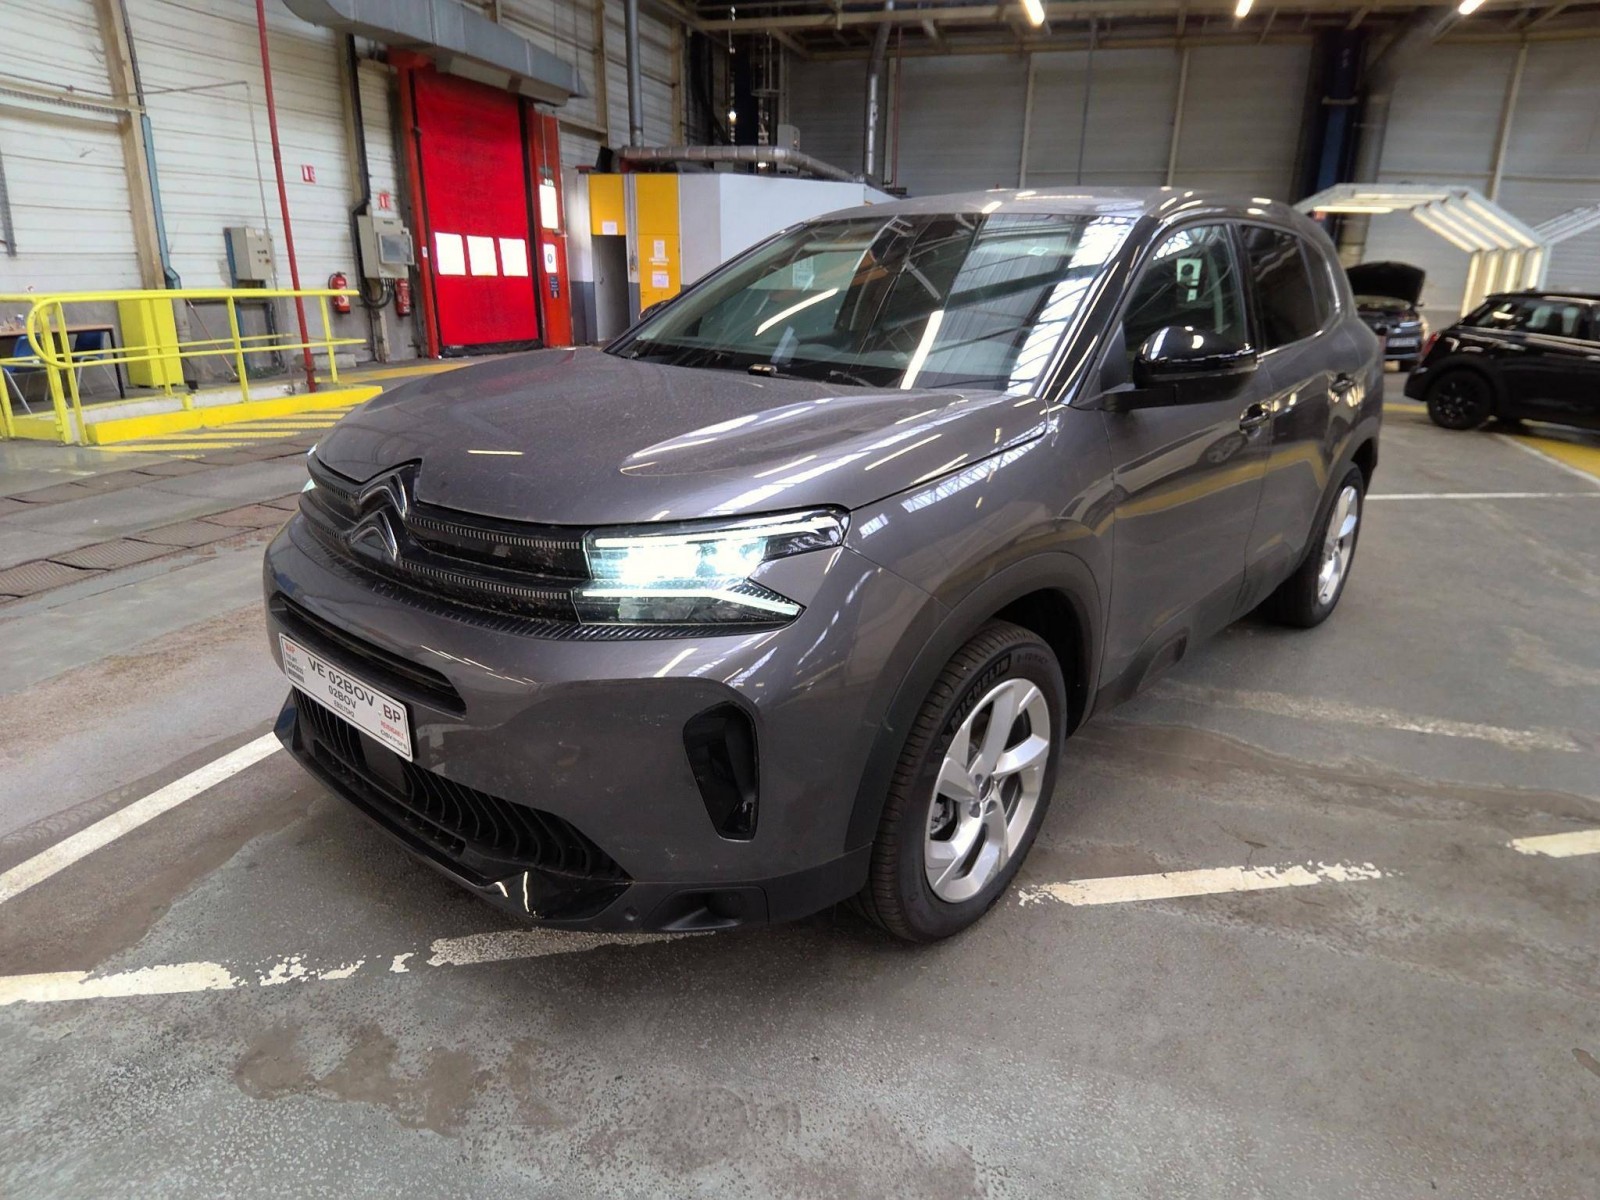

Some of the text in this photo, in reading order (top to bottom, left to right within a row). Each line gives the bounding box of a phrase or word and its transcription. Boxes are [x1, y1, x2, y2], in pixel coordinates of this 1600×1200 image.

[308, 657, 326, 678] VE
[329, 671, 374, 707] 02BOV
[329, 685, 356, 709] 02BOV
[949, 654, 1010, 730] MICHELIN
[383, 704, 401, 723] BP
